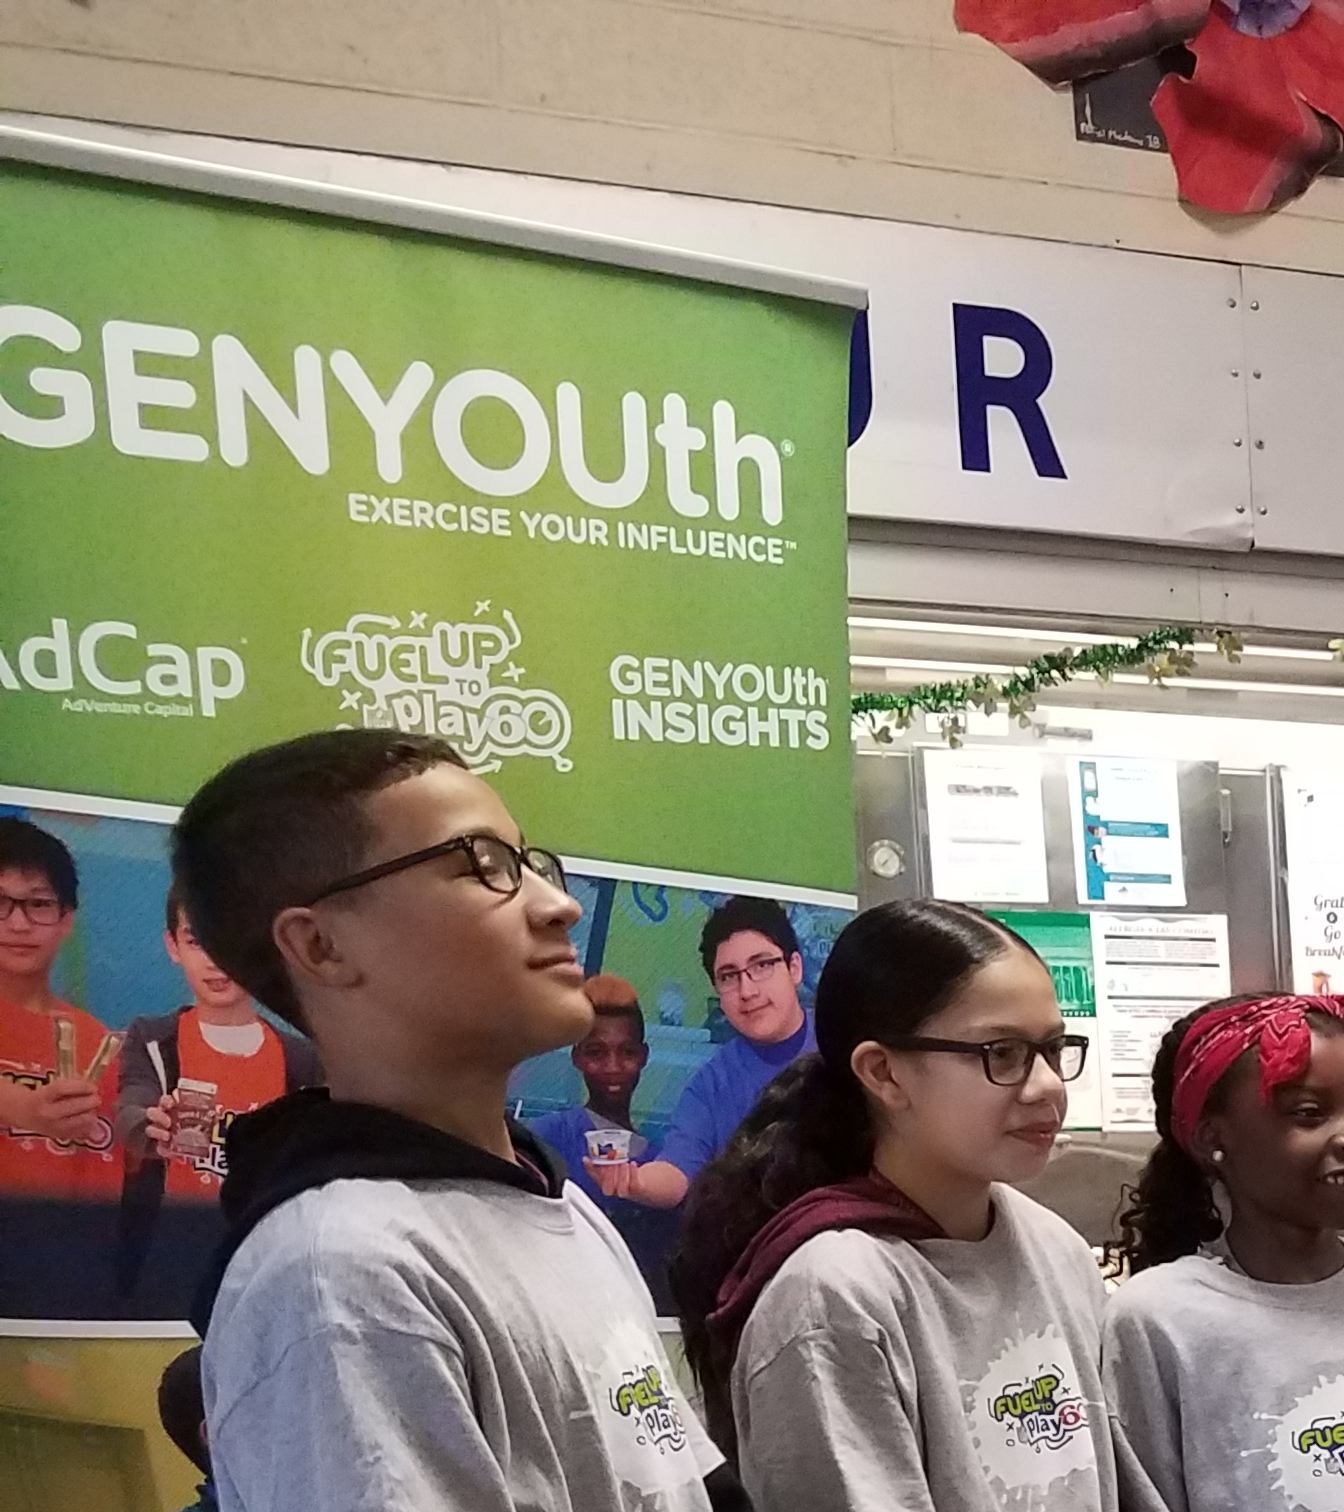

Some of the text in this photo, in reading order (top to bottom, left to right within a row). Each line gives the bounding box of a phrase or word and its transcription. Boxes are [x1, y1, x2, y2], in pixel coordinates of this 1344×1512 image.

[349, 493, 512, 538] EXERCISE
[520, 510, 608, 548] YOUR
[321, 629, 503, 686] FUEL UP
[144, 701, 194, 717] Capital
[455, 678, 482, 697] TO
[611, 698, 831, 751] INSIGHTS
[1323, 924, 1341, 944] Go
[995, 1376, 1058, 1420] FUEL UP
